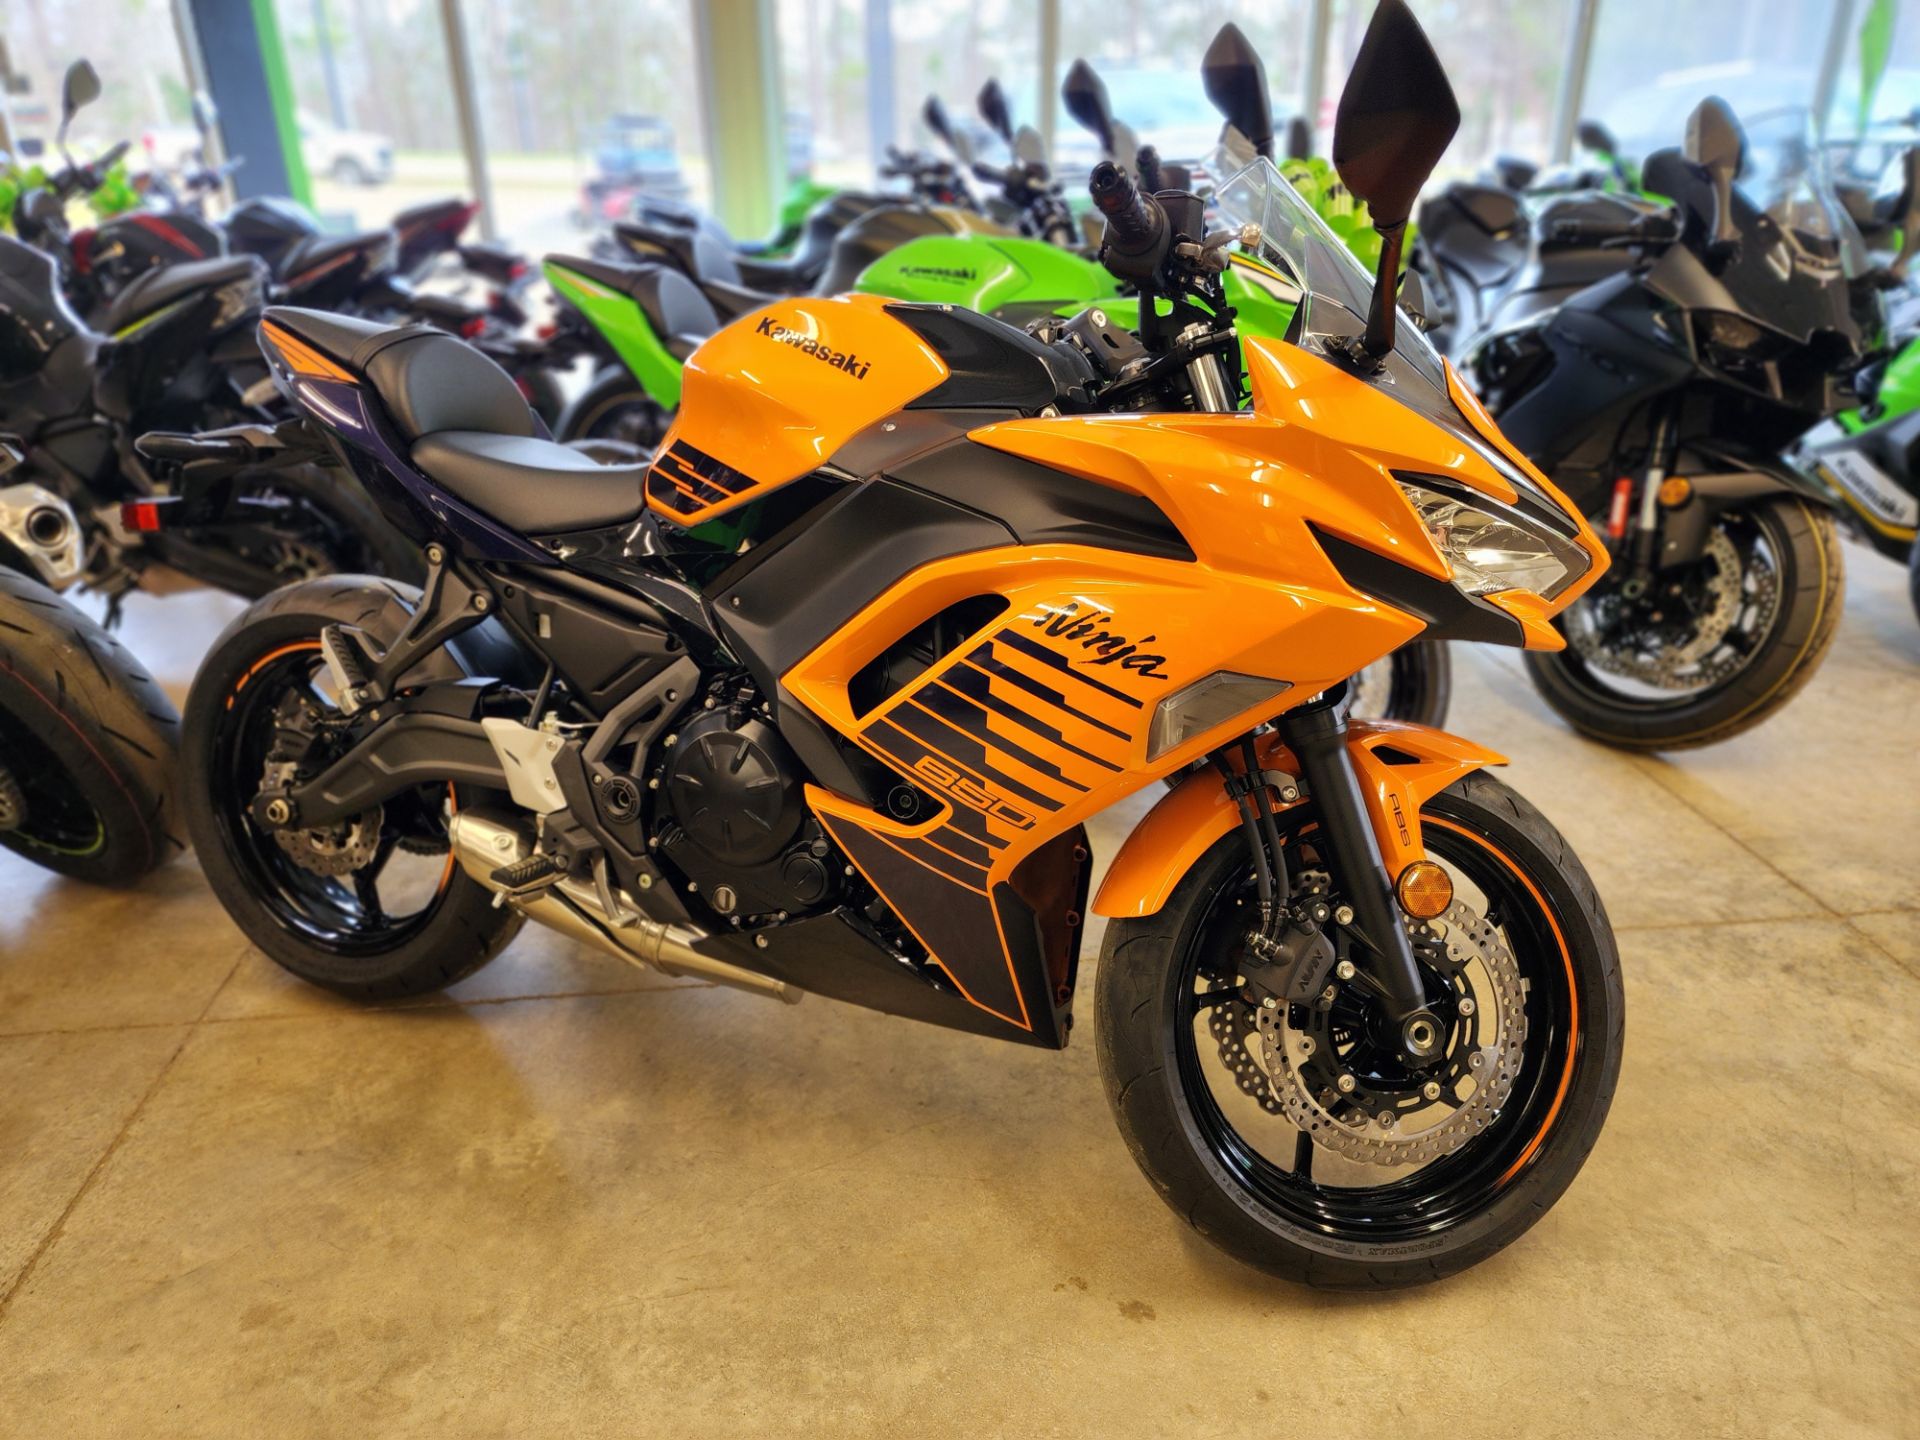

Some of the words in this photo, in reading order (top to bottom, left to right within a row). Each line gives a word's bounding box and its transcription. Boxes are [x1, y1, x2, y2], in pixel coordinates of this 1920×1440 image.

[755, 316, 872, 381] Kawasaki
[1033, 602, 1168, 680] Ninja
[913, 754, 1037, 831] 650
[1389, 794, 1411, 847] ABS
